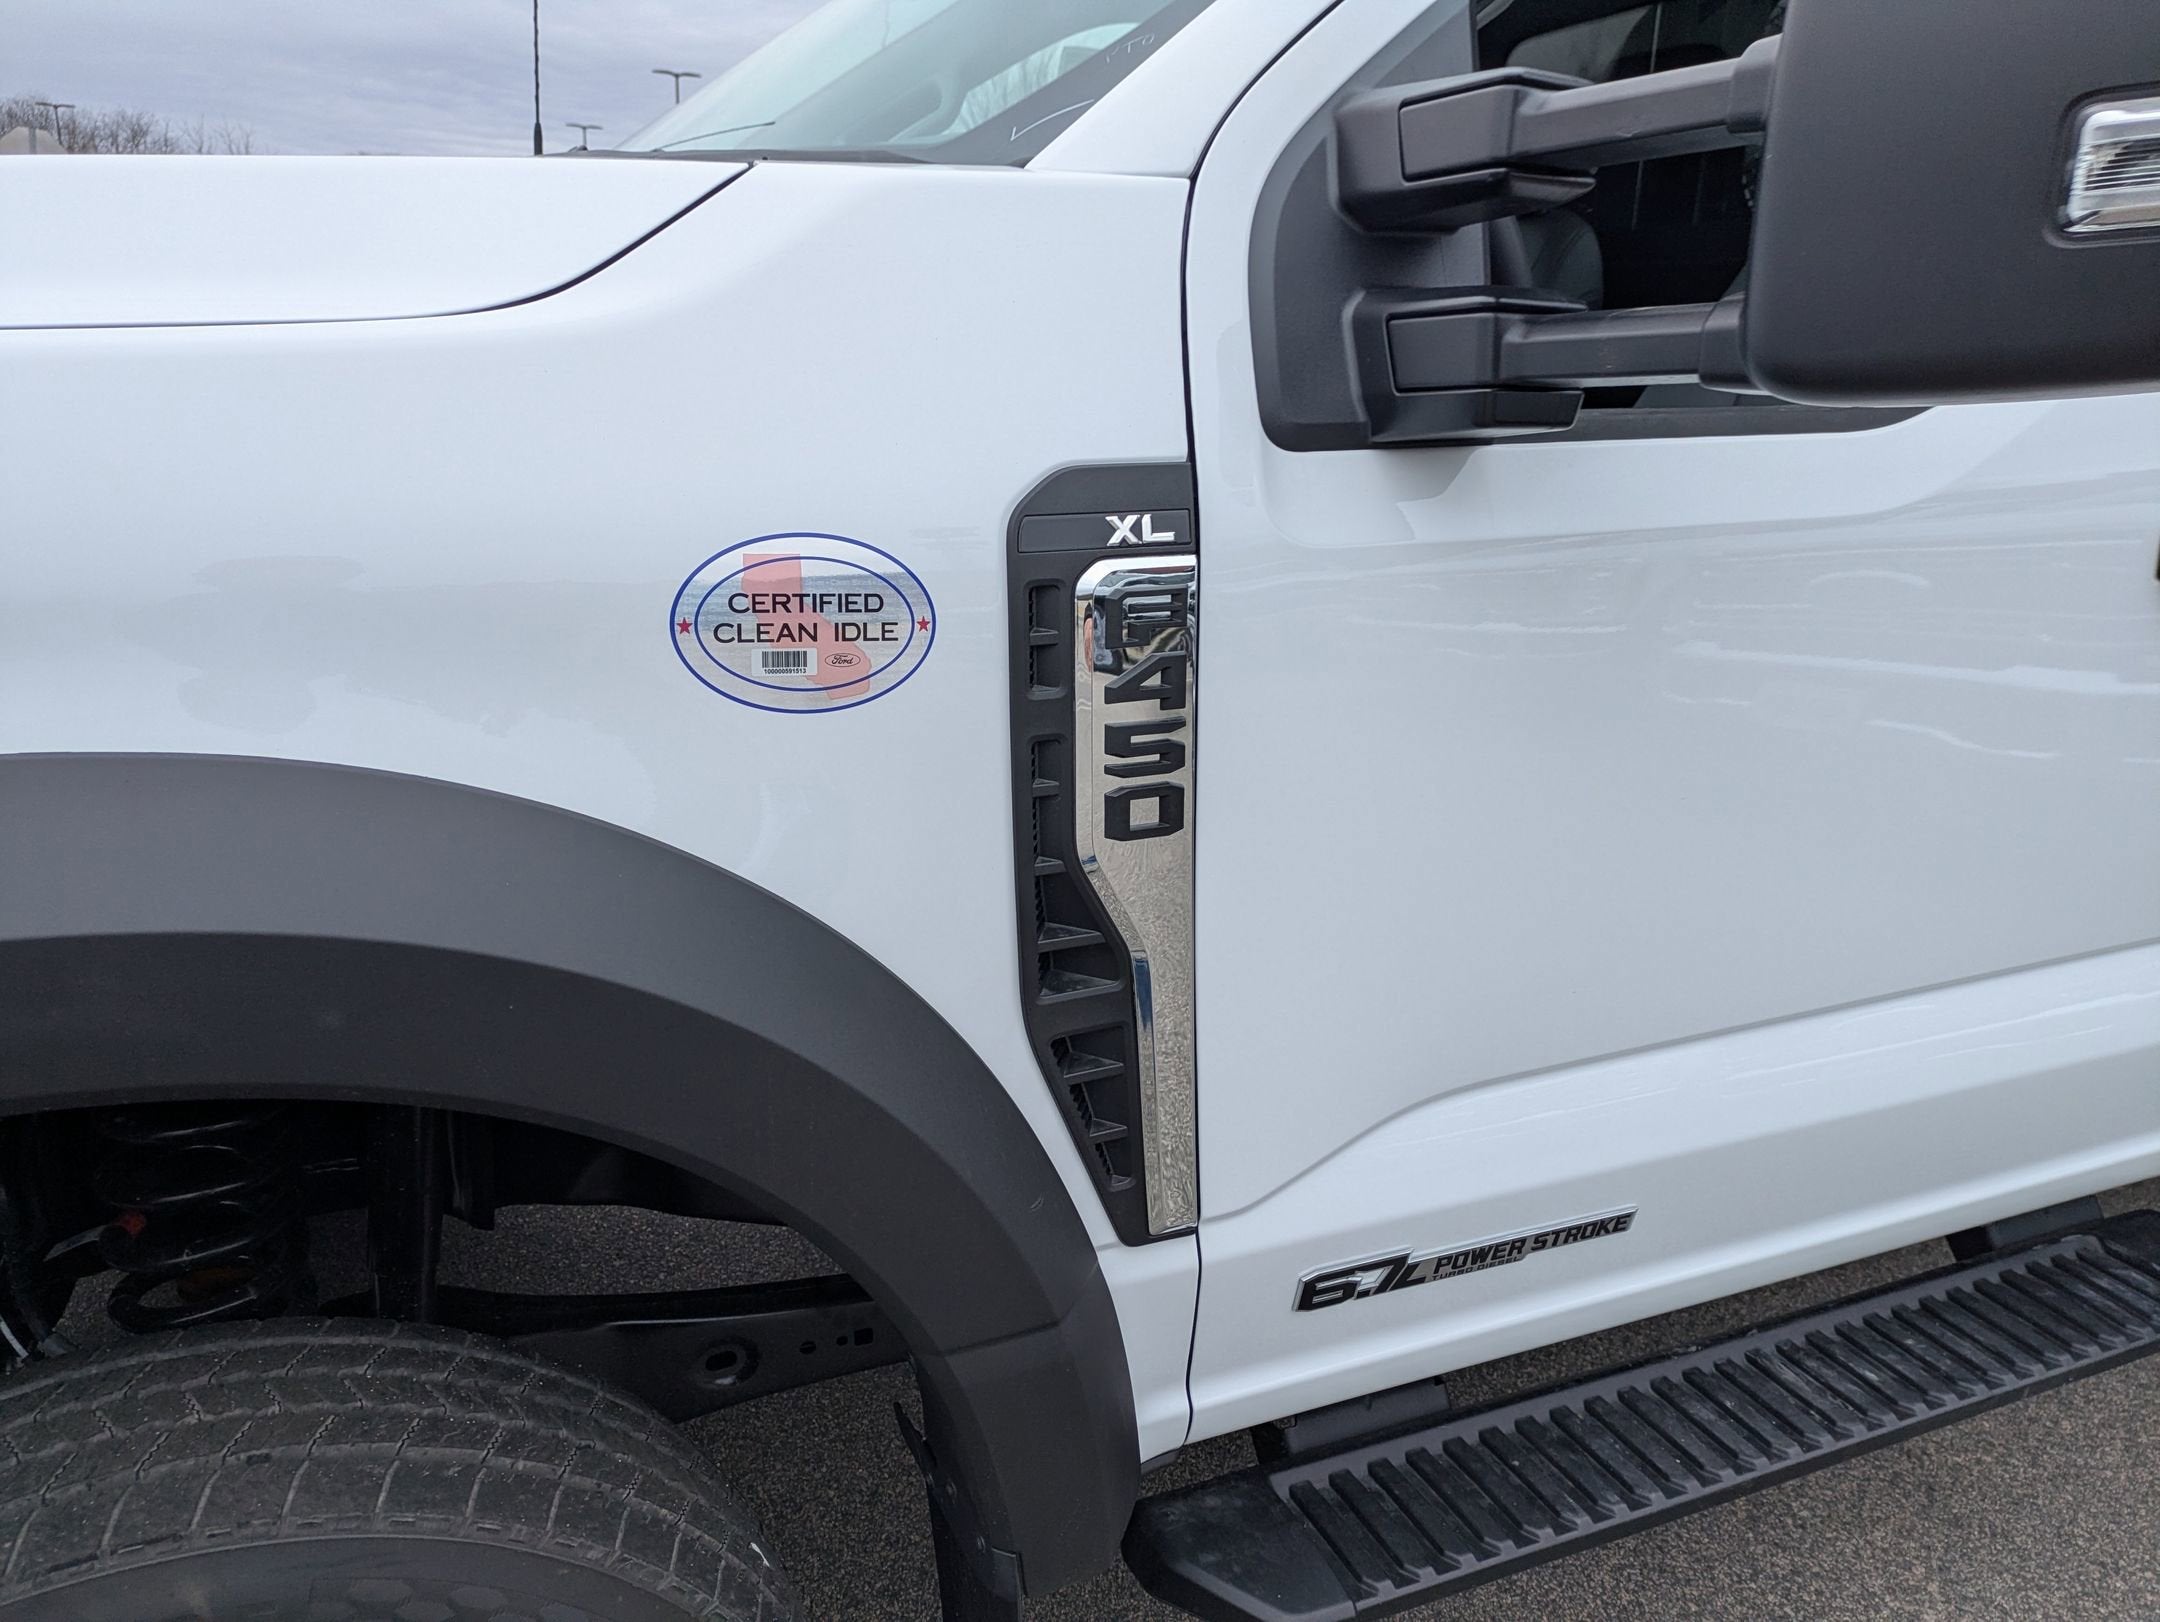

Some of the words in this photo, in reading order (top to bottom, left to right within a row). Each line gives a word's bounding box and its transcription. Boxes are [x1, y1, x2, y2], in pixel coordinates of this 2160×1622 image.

[1105, 513, 1176, 547] XL
[728, 593, 884, 613] CERTIFIED
[713, 622, 818, 644] CLEAN
[834, 621, 899, 642] IDLE
[1297, 1247, 1427, 1312] 6.7L
[1433, 1238, 1527, 1274] POWER
[1530, 1213, 1632, 1251] STROKE
